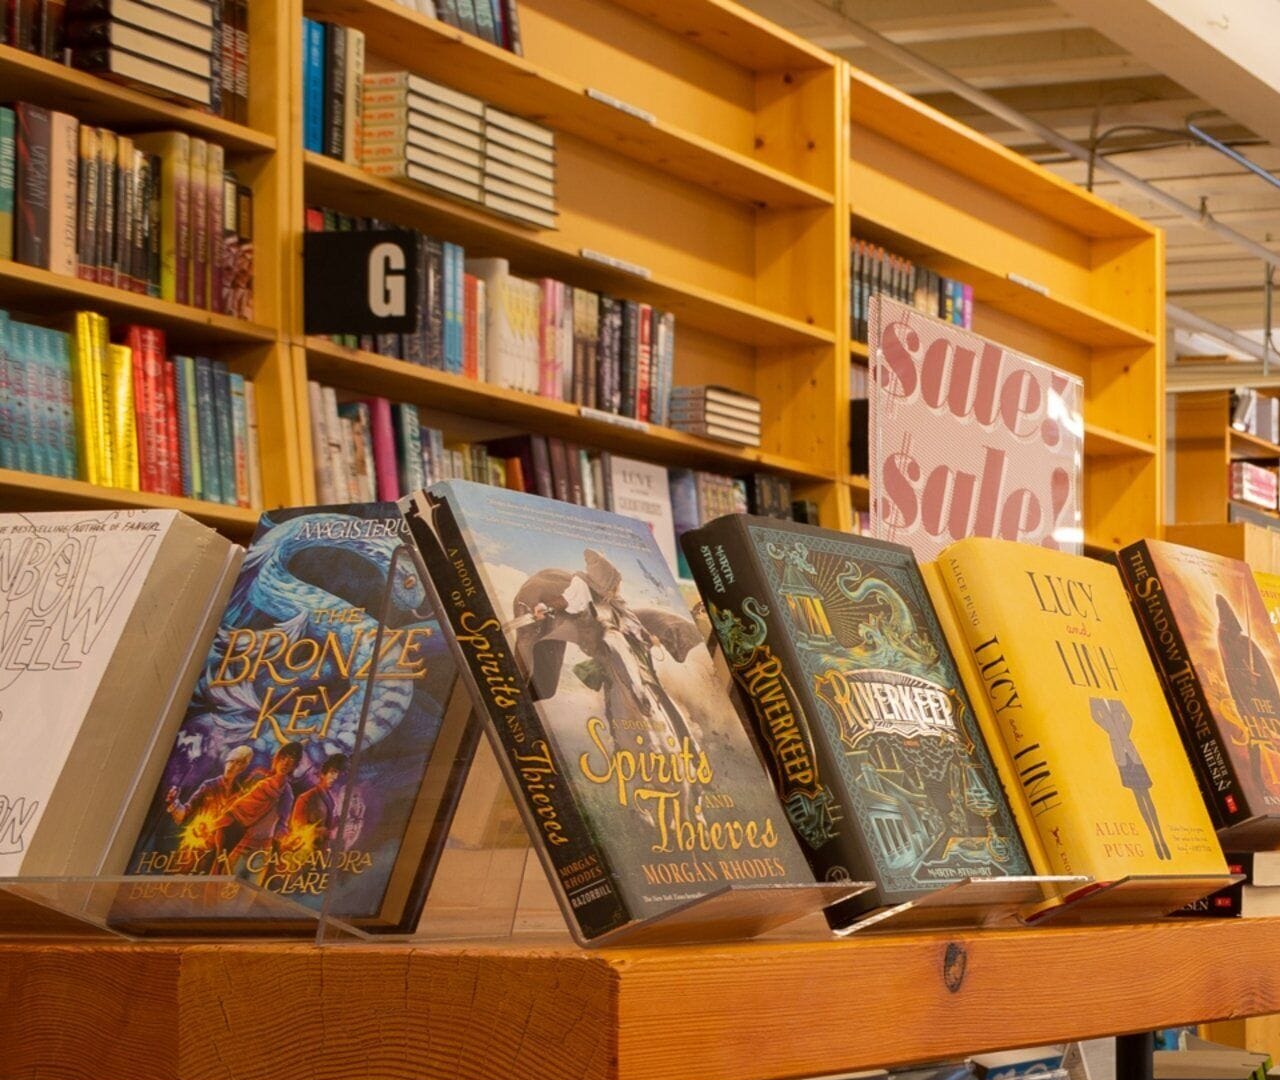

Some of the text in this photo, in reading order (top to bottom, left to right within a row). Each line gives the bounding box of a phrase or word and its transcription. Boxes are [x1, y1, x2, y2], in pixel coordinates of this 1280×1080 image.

[368, 243, 407, 317] G
[311, 606, 367, 626] THE
[948, 558, 980, 628] ALICE PUNG
[1025, 571, 1102, 624] LUCY
[210, 626, 434, 689] BRONZE
[1056, 640, 1130, 693] LINH
[1128, 550, 1210, 739] THE SHADOW THRONE
[247, 684, 359, 747] KEY
[460, 611, 513, 711] Spirits
[515, 736, 570, 848] Thieves
[743, 656, 815, 790] RIVERKEEP
[833, 672, 957, 732] RIVERKEEP
[973, 633, 1022, 716] LUCY
[1013, 743, 1063, 818] LINH
[1252, 697, 1275, 715] THE
[580, 716, 715, 807] Spirits
[634, 788, 780, 854] Thieves
[1094, 820, 1139, 839] ALICE
[1103, 842, 1146, 860] PUNG
[136, 849, 210, 876] HOLLY
[245, 845, 375, 877] CASSANDRA
[261, 872, 332, 896] CLARE
[641, 856, 787, 886] MORGAN RHODES
